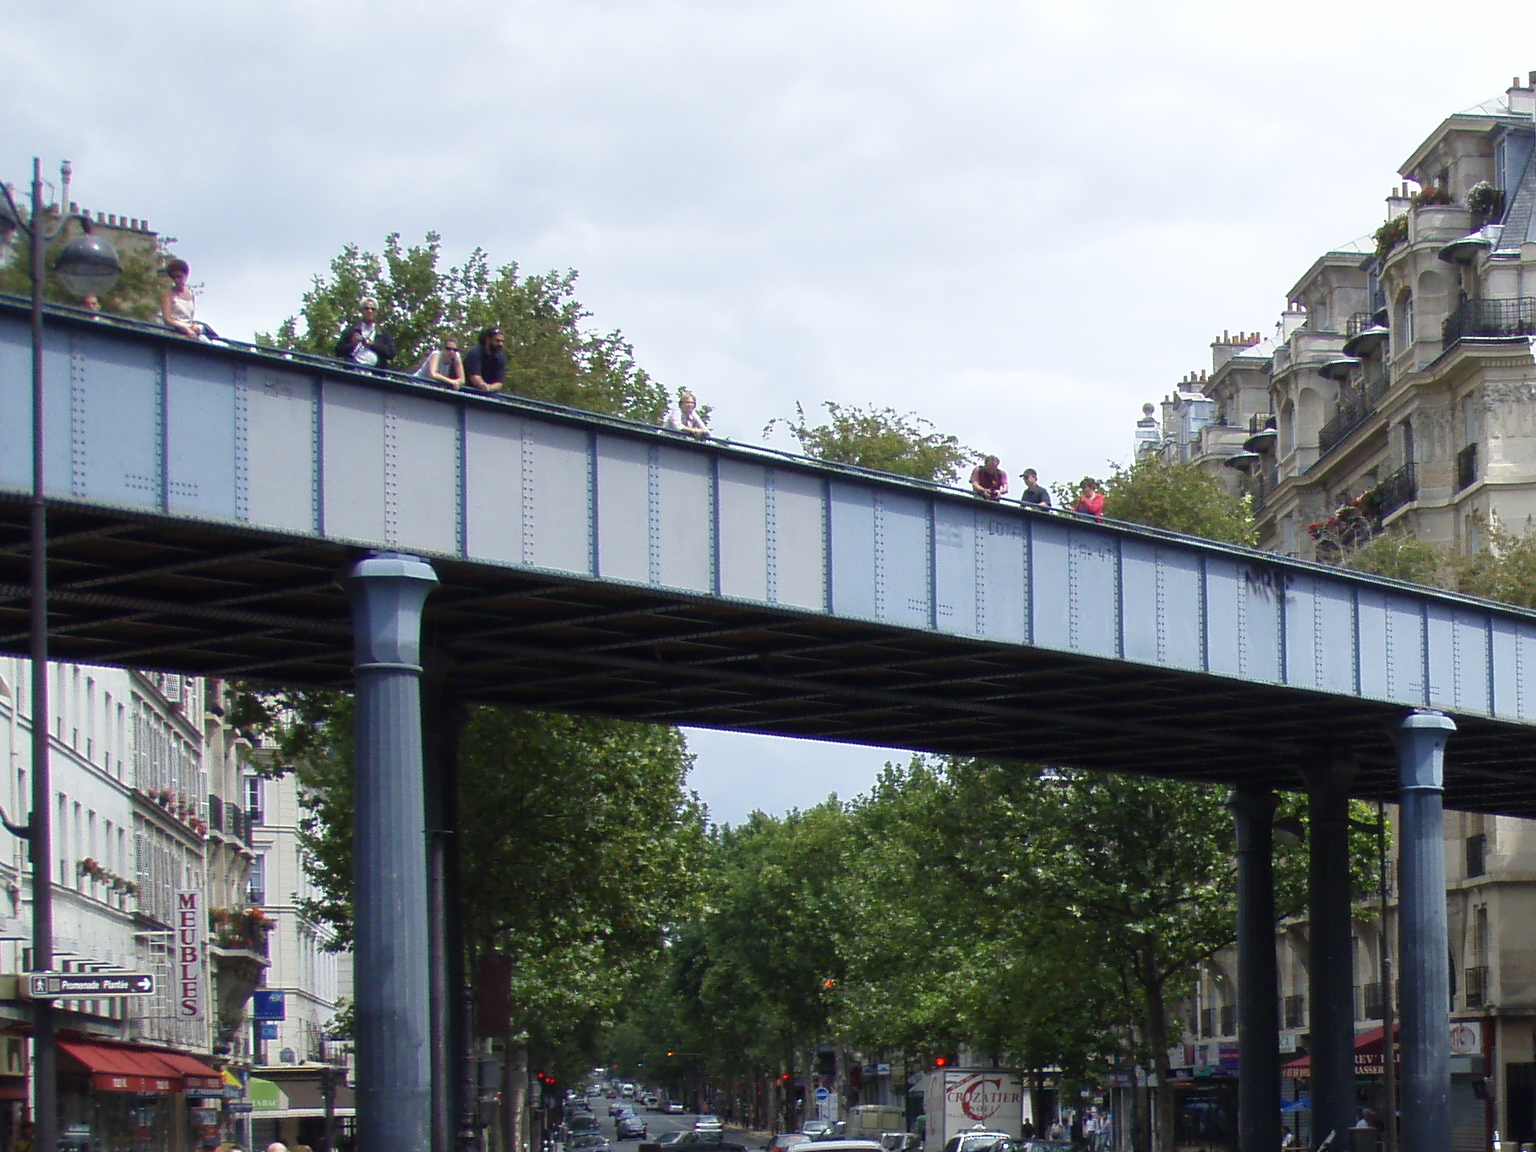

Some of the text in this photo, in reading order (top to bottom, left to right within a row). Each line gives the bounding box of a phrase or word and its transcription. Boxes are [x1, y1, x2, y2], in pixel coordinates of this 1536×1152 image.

[178, 893, 198, 1016] MEUBLES
[61, 980, 100, 990] Promenade
[947, 1092, 1020, 1103] CROZATIER
